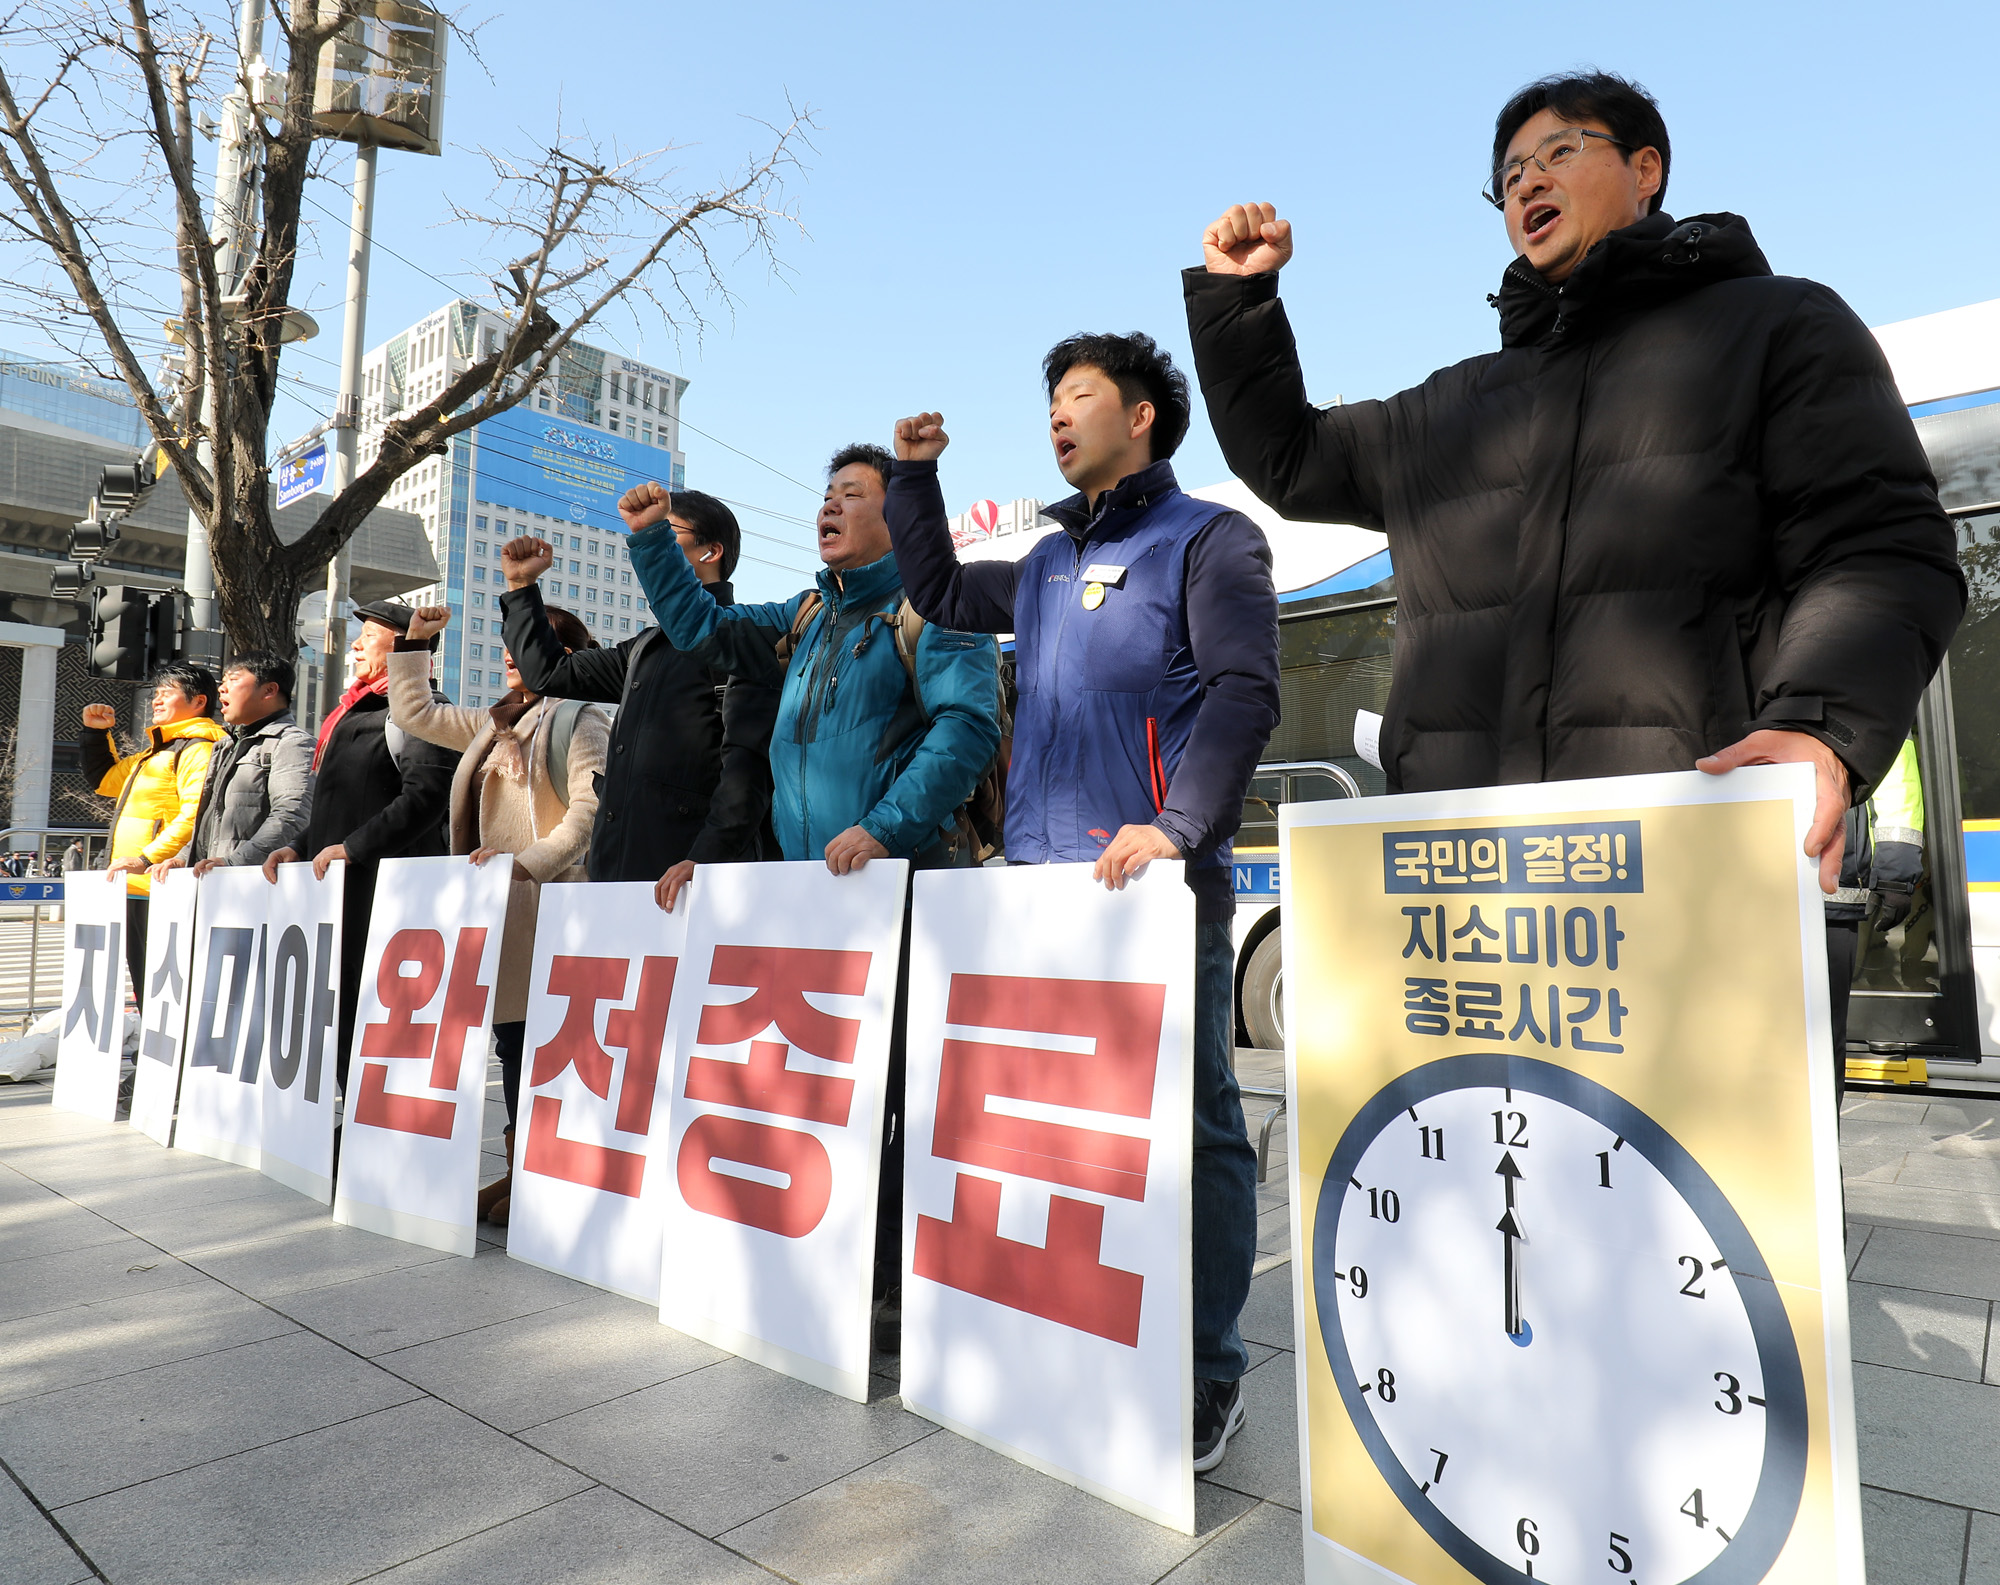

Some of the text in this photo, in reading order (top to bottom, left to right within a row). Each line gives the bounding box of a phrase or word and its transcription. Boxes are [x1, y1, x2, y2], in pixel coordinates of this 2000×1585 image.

[621, 360, 671, 385] 외교부 MOFA
[280, 477, 314, 502] Sambong-ro
[281, 463, 305, 487] 삼봉
[1394, 833, 1628, 885] 국민의 결정!
[1401, 904, 1625, 971] 지소미아
[1404, 977, 1629, 1054] 종료시간
[1418, 1126, 1447, 1161] 11
[1491, 1110, 1529, 1149] 12
[1595, 1151, 1613, 1189] 1
[1367, 1187, 1400, 1224] 10
[1350, 1265, 1368, 1299] 9
[1678, 1256, 1706, 1299] 2
[1376, 1367, 1397, 1403] 8
[1714, 1372, 1742, 1415] 3
[1430, 1448, 1449, 1484] 7
[1680, 1488, 1709, 1527] 4
[1516, 1517, 1540, 1556] 6
[1607, 1532, 1633, 1574] 5
